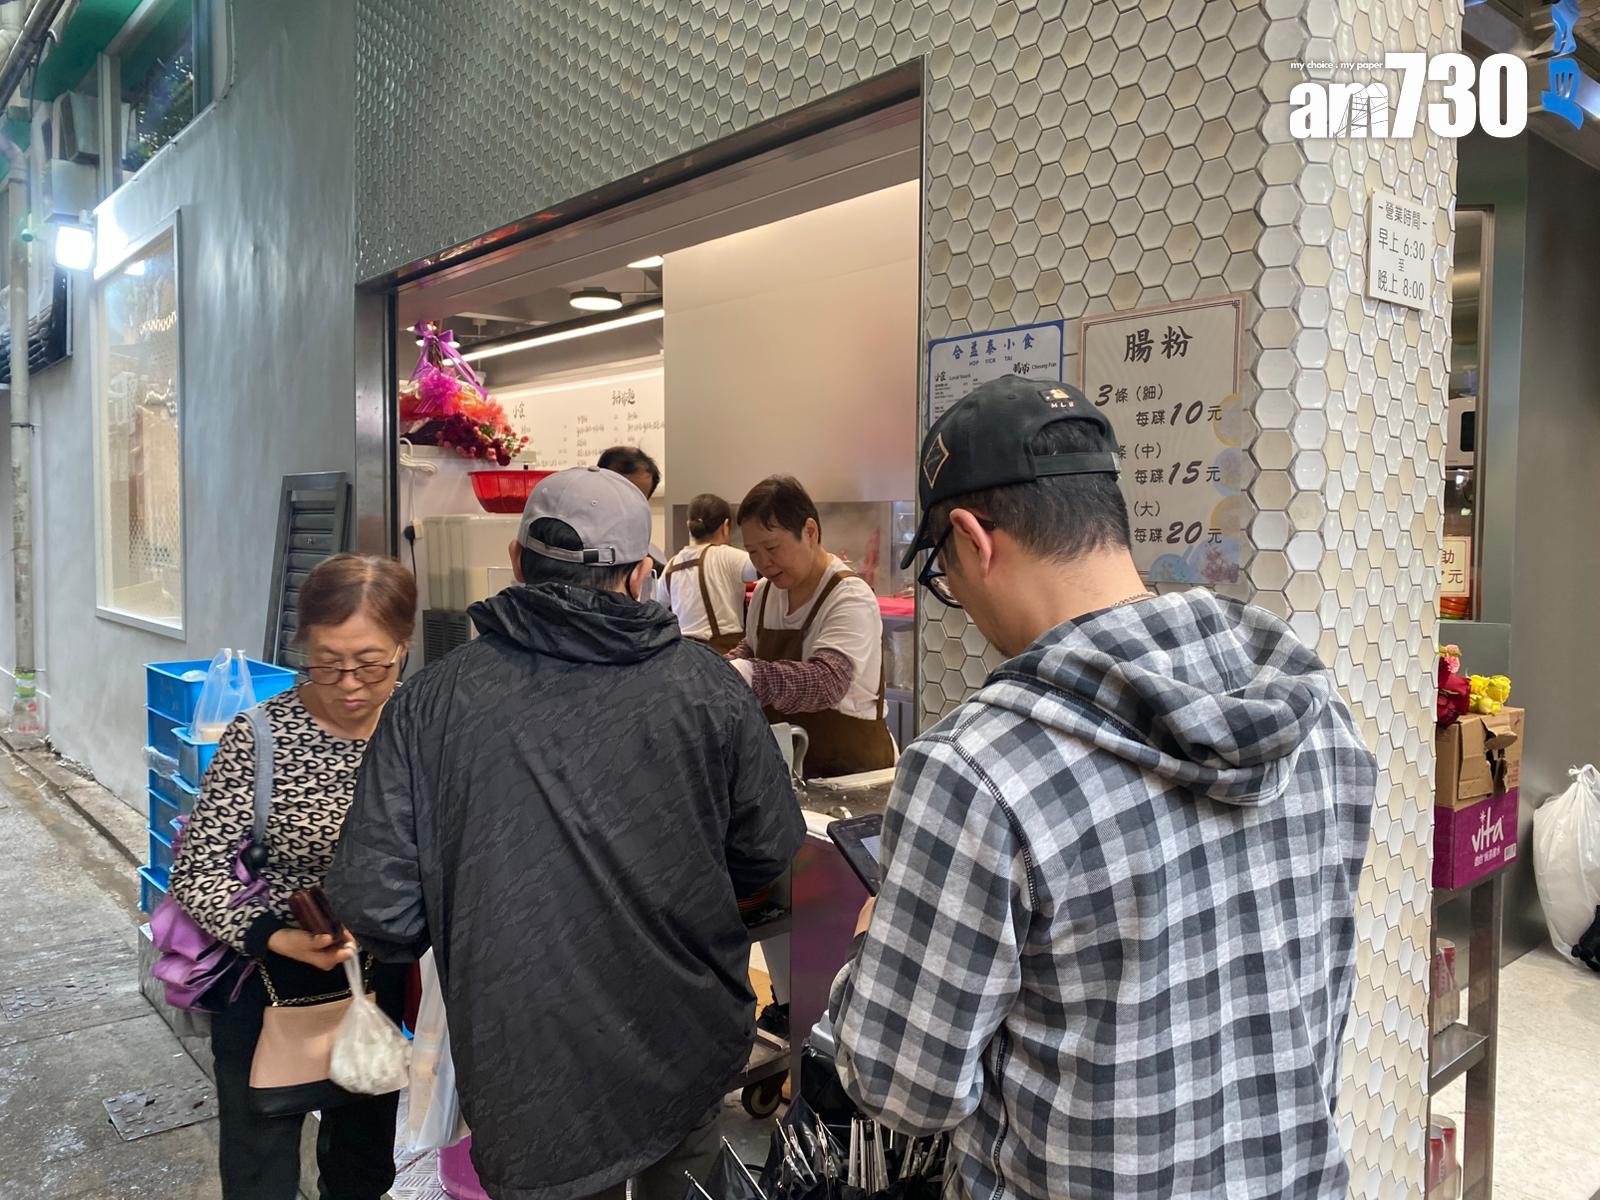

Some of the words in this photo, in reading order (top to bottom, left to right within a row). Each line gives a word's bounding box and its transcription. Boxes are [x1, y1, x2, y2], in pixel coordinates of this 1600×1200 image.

[1403, 238, 1426, 261] 6:30
[1403, 278, 1425, 301] 8:00
[952, 333, 1035, 360] 合益泰小食
[1123, 326, 1194, 363] 腸粉
[1472, 806, 1504, 852] vita
